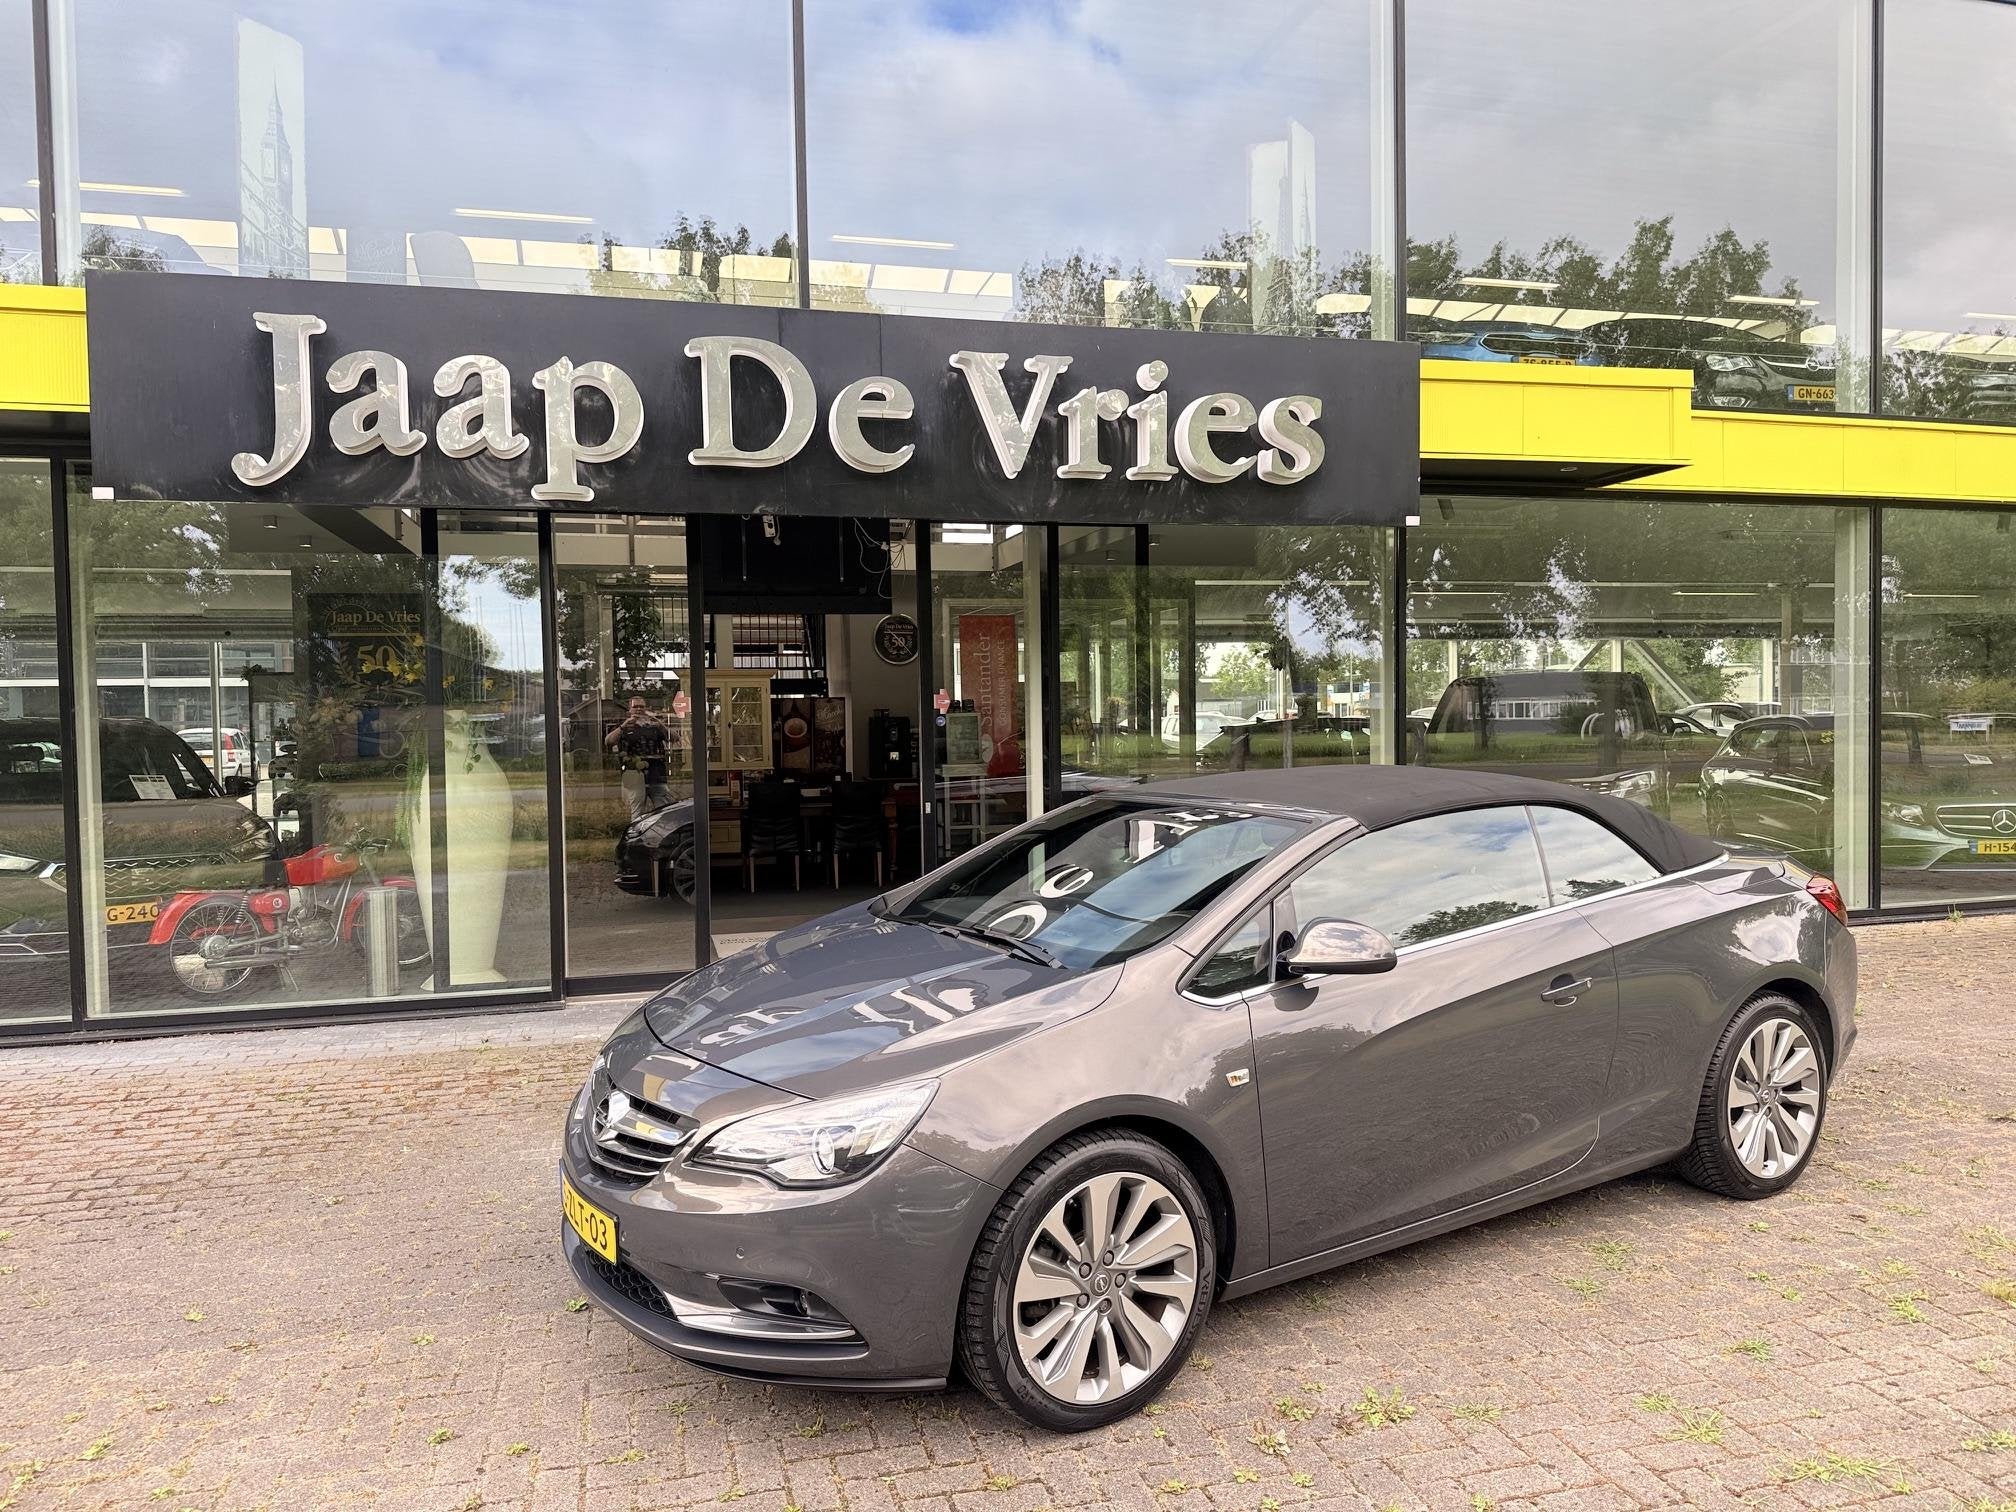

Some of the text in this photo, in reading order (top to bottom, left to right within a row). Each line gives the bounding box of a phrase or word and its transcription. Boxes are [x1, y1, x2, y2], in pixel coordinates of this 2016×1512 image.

[231, 312, 1326, 502] Jaap De Vries
[330, 609, 421, 625] Jaap De Vries
[973, 632, 993, 728] Santander
